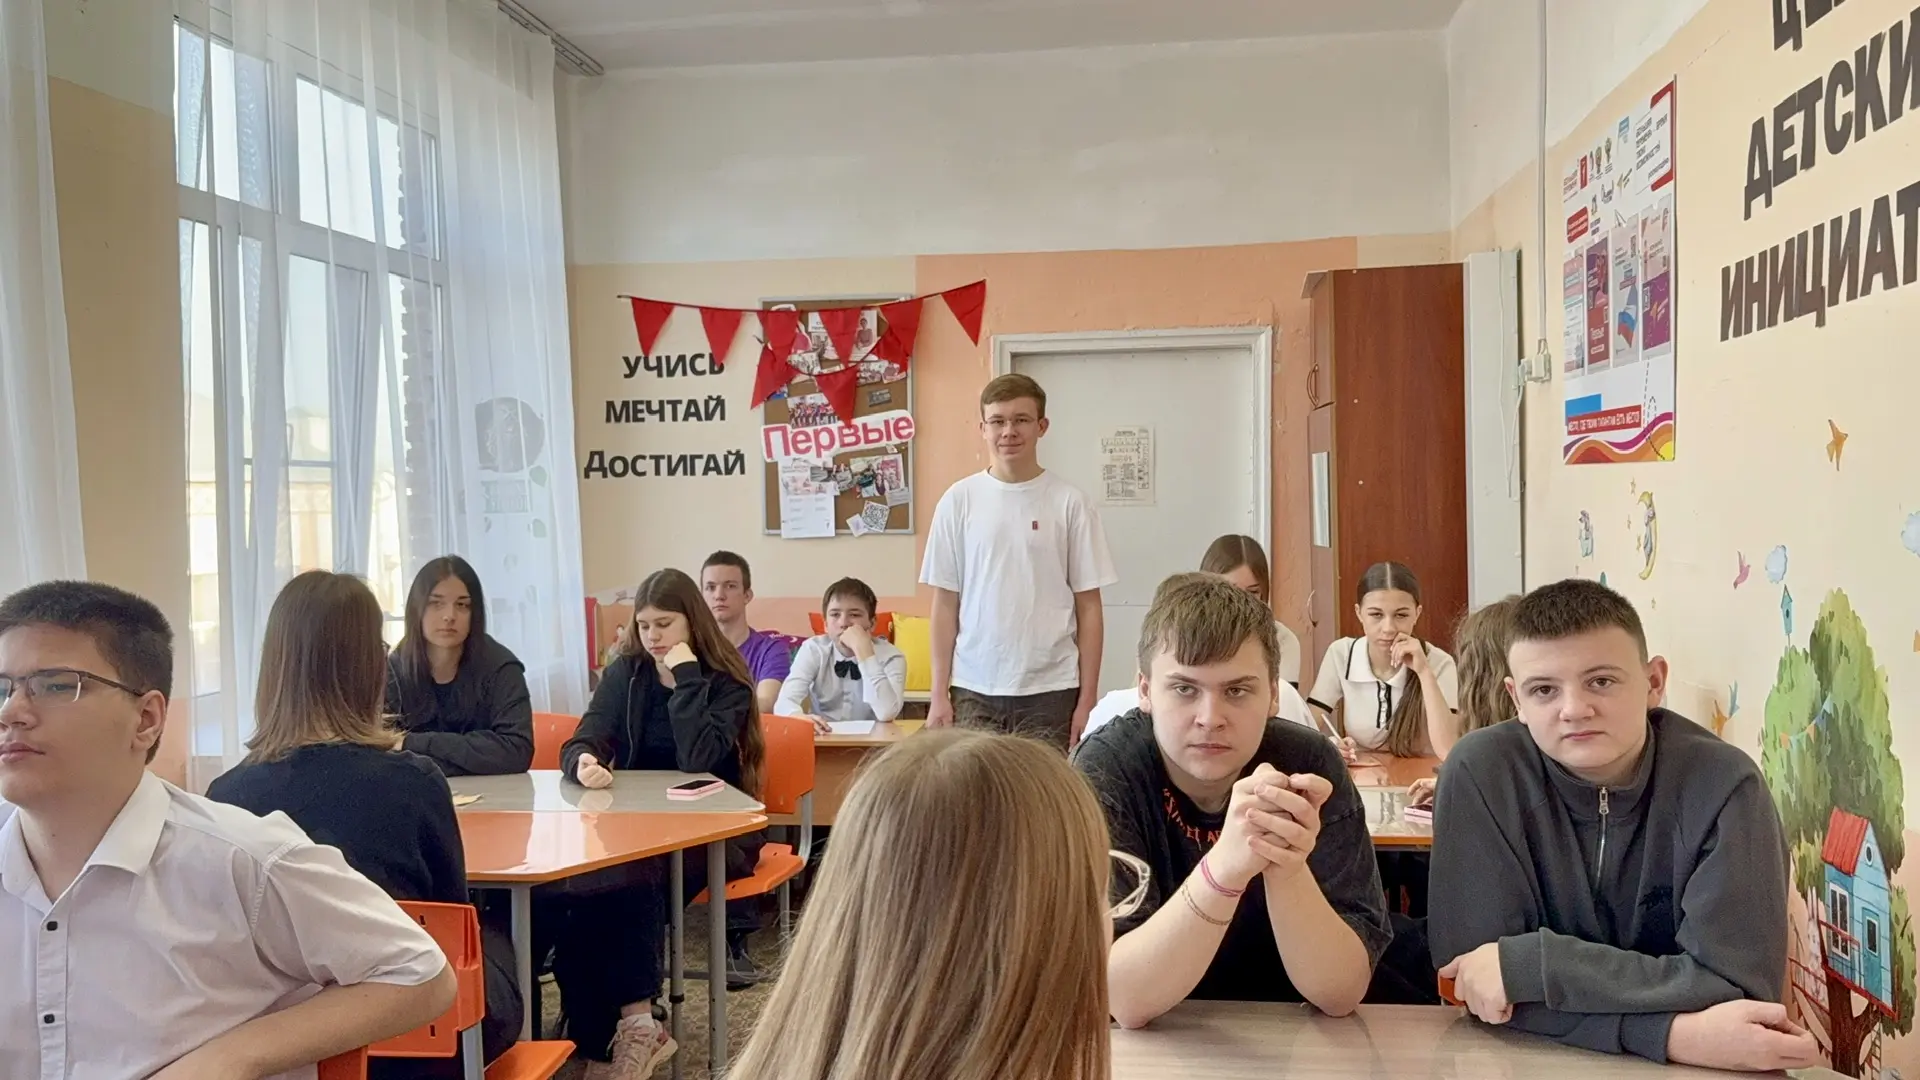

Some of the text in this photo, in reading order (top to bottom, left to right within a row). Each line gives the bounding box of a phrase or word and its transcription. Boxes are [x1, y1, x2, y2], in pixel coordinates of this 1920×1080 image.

[1744, 5, 1920, 220] ДЕТСКИ
[1720, 180, 1920, 342] ИНИЦИАТ
[605, 395, 726, 423] МЕЧТАЙ
[763, 415, 914, 458] Первые
[584, 449, 746, 479] ДОСТИГАЙ
